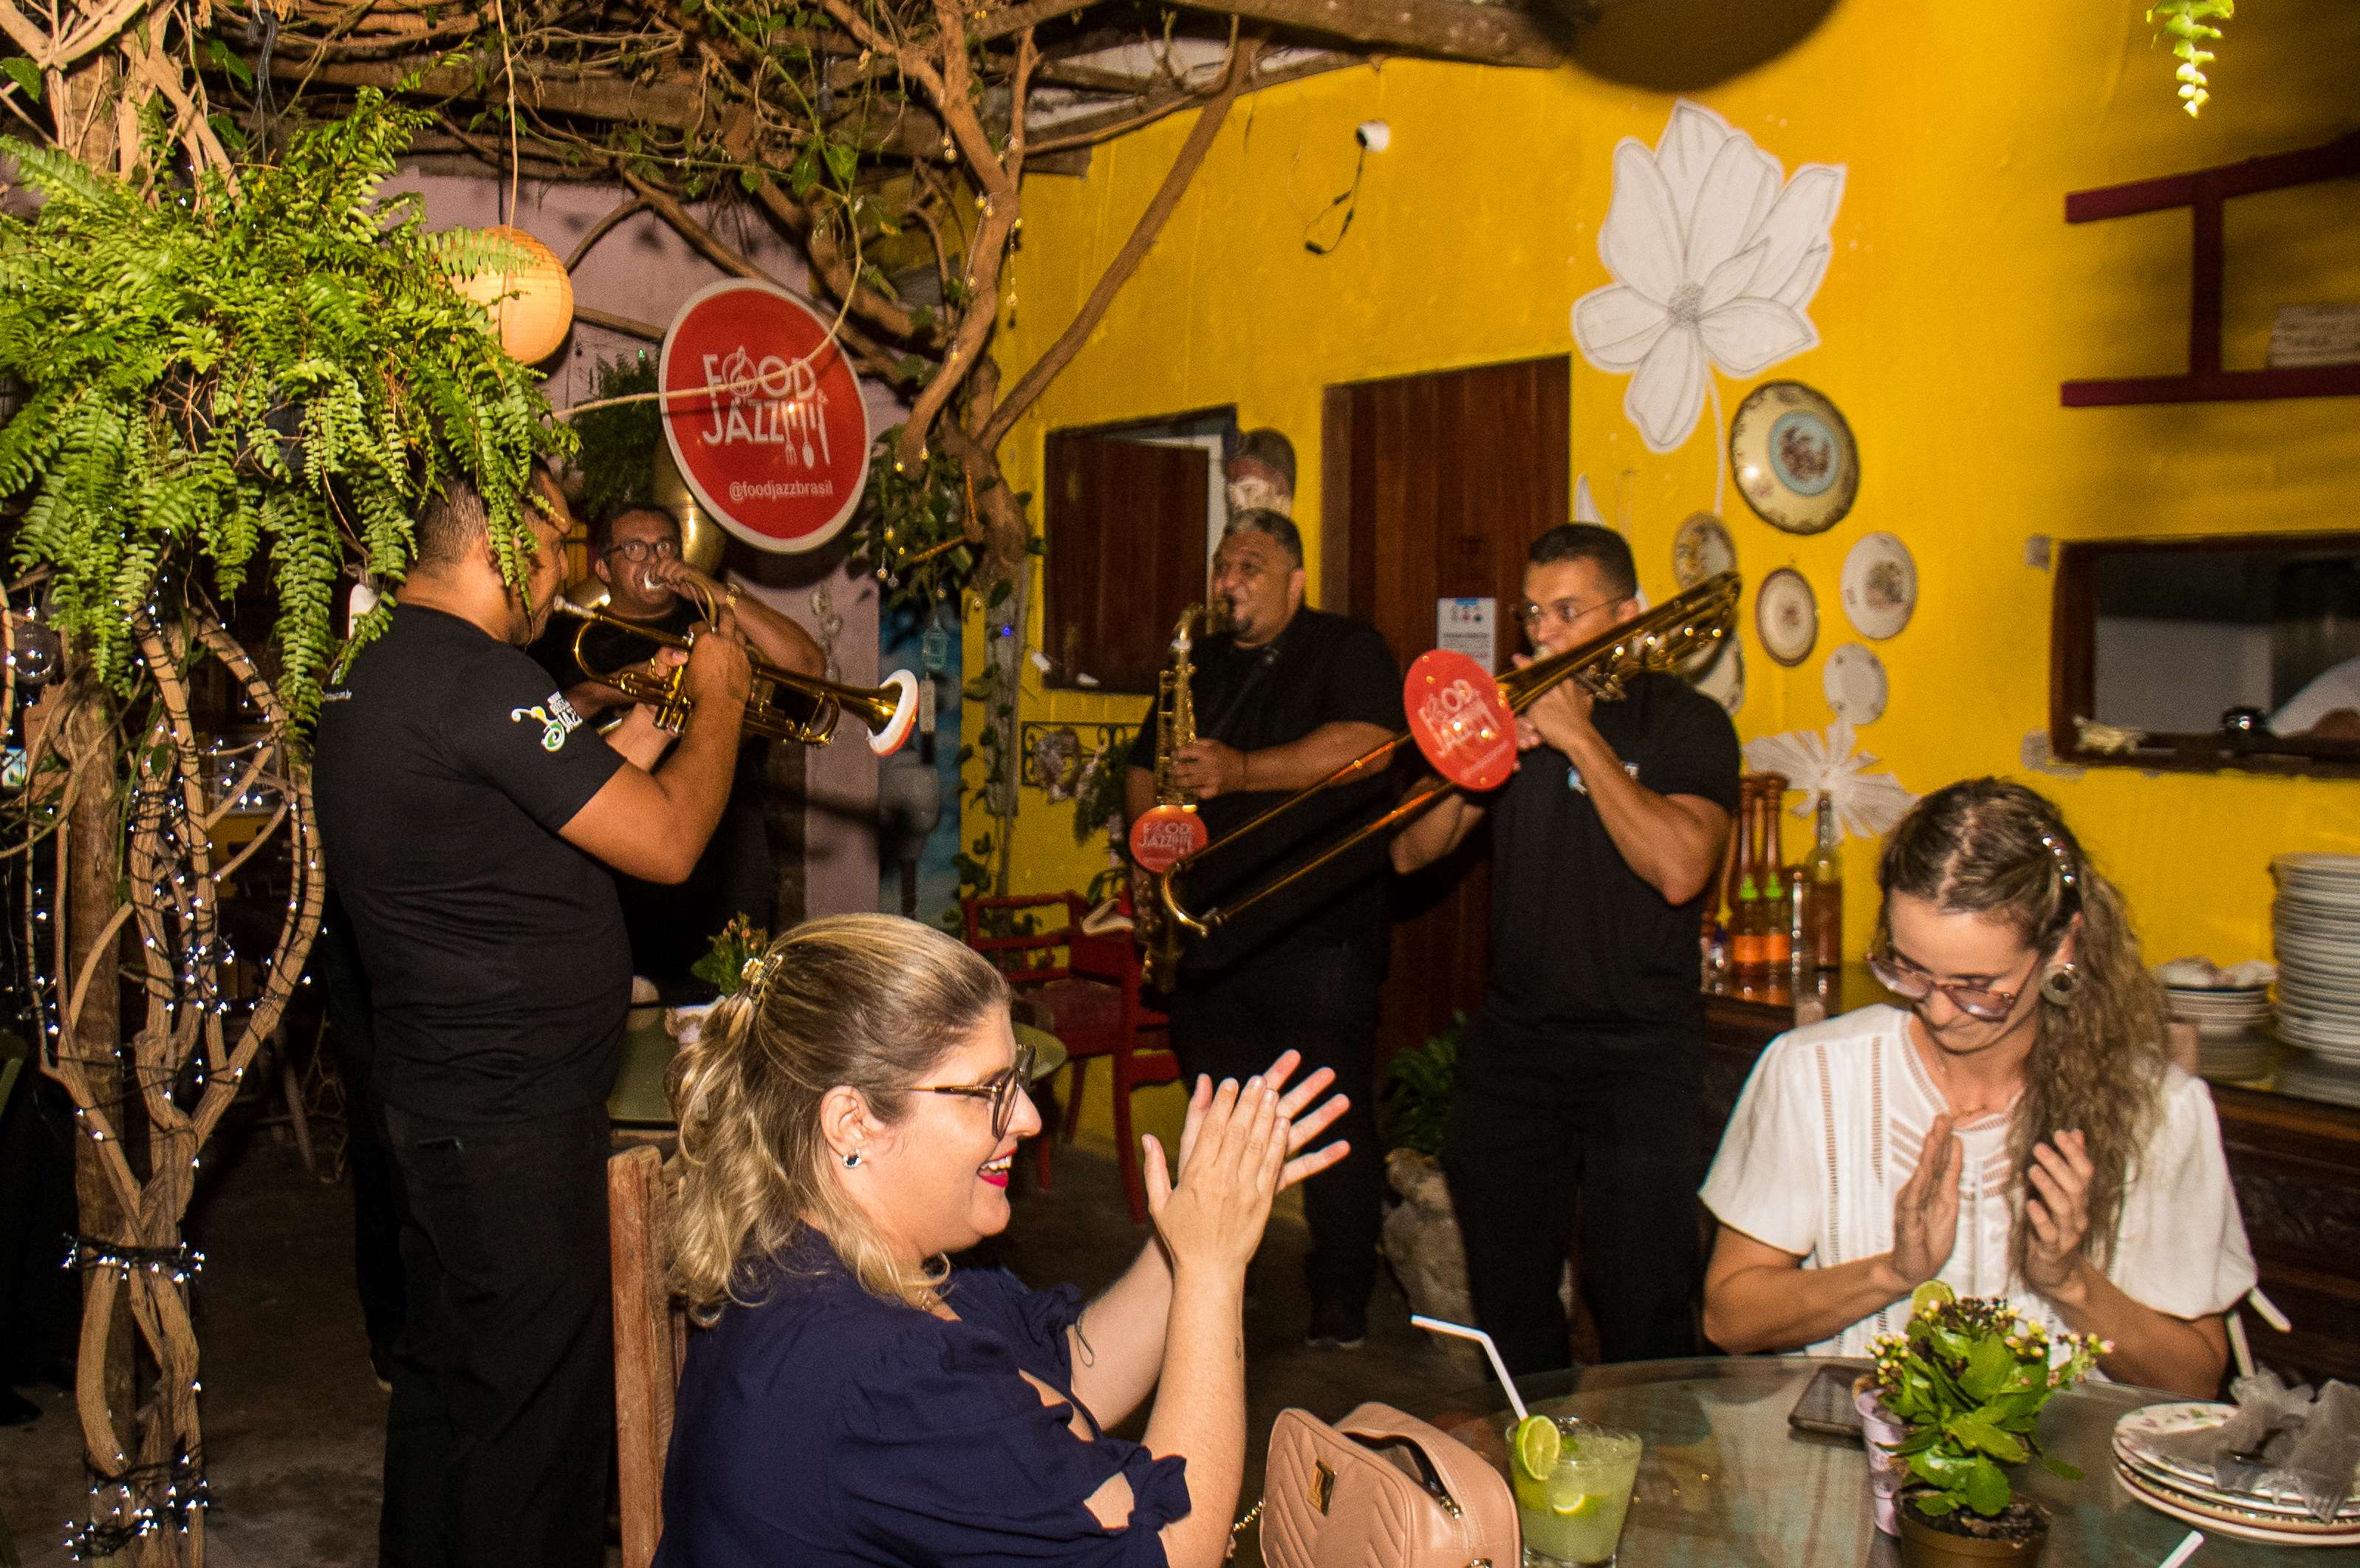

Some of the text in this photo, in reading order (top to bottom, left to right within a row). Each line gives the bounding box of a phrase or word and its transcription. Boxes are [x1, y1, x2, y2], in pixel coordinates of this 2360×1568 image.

[703, 347, 816, 399] FOOD
[702, 399, 785, 446] JAZZ
[729, 480, 833, 502] @foodjazzbrasil
